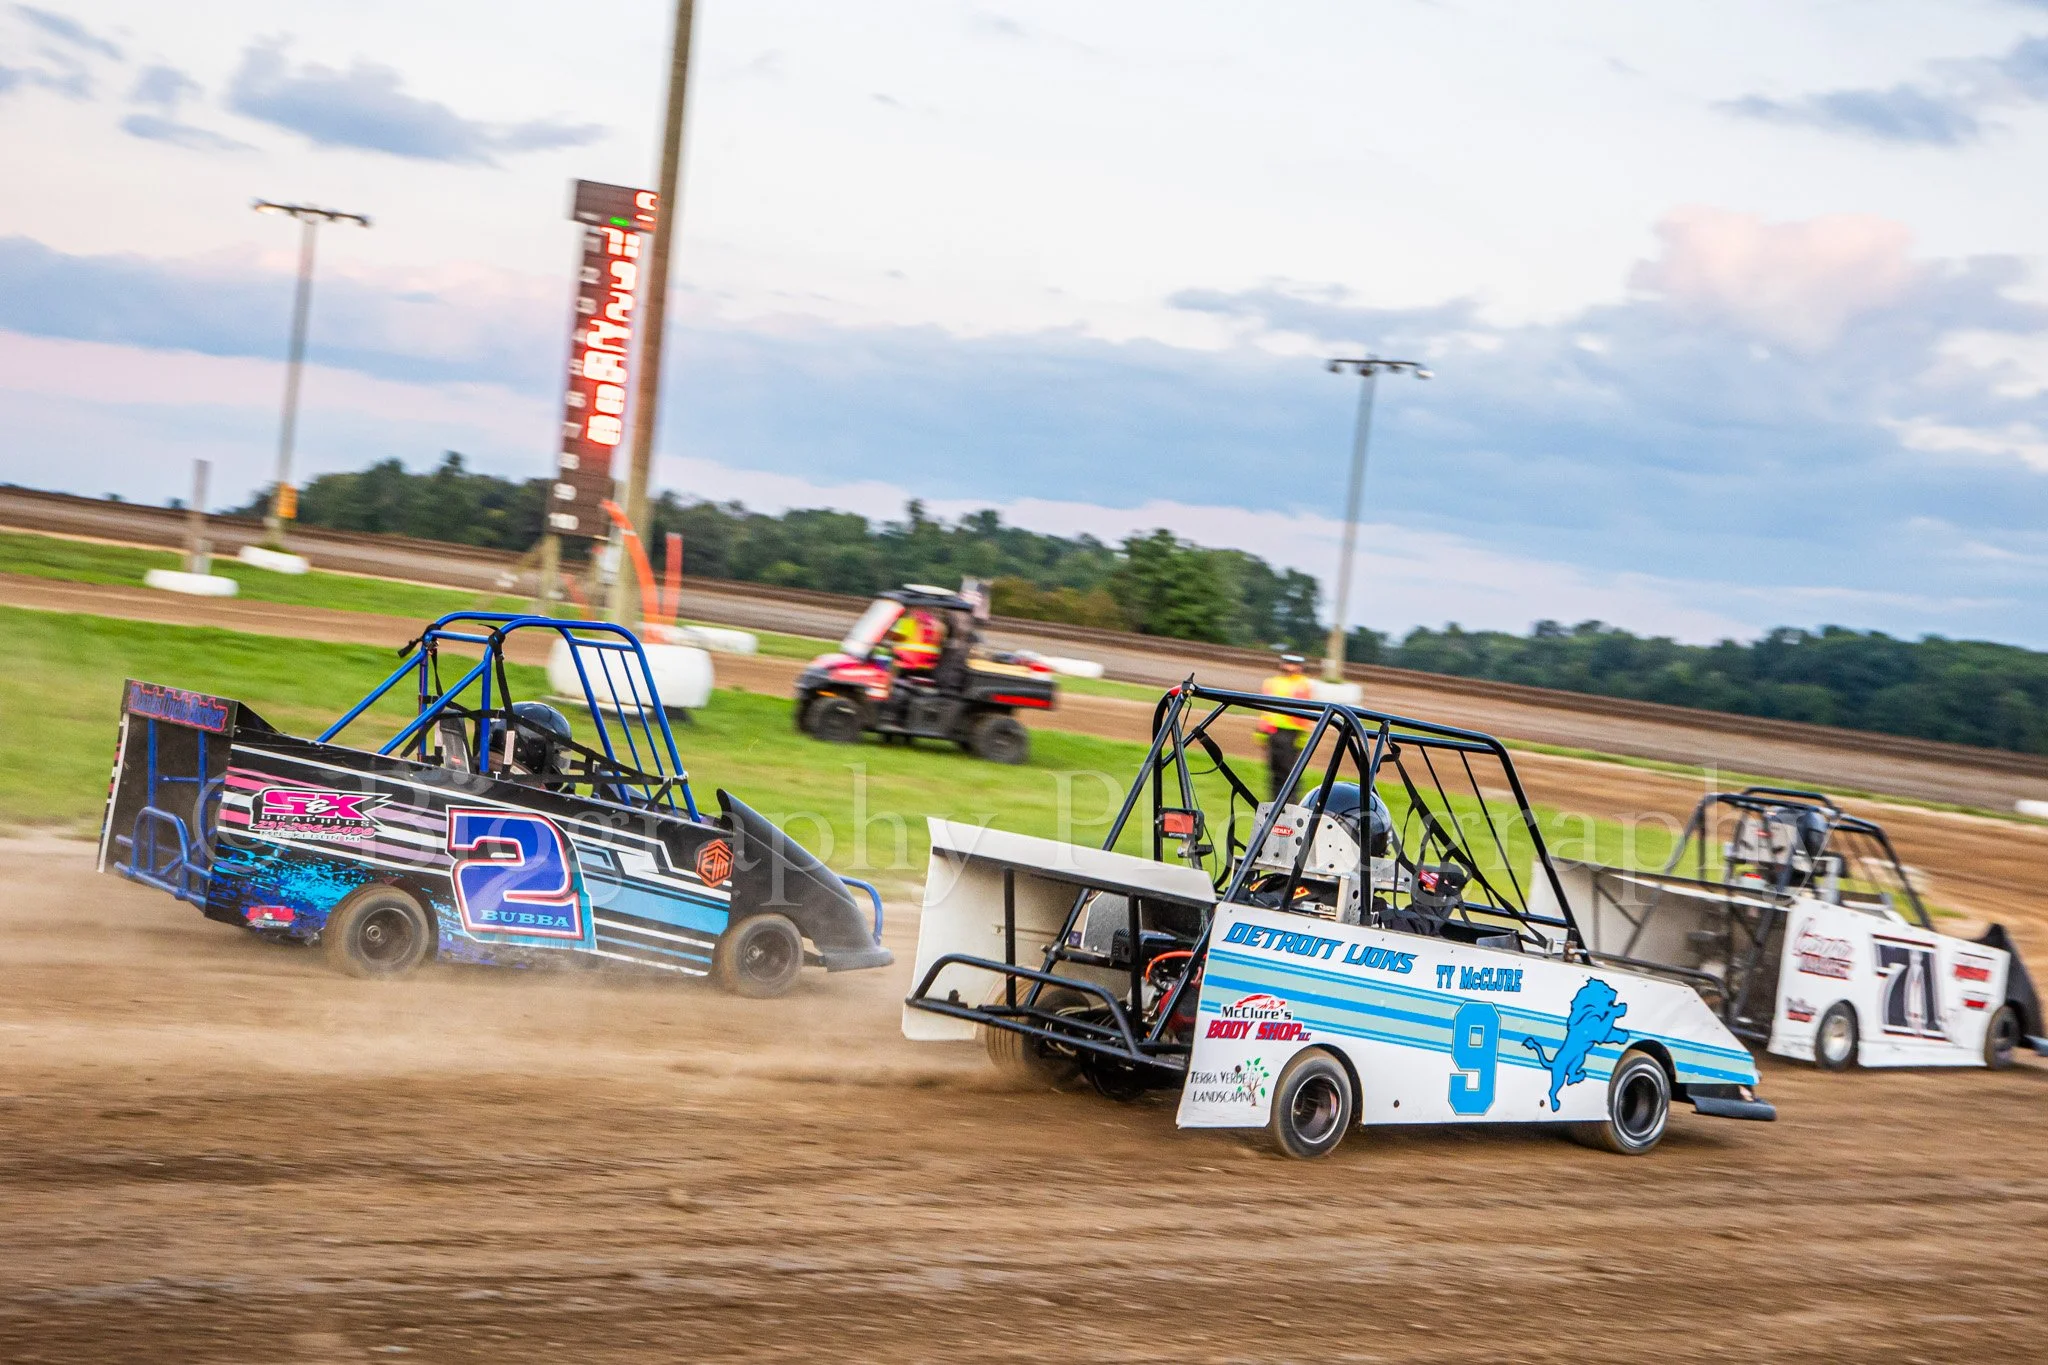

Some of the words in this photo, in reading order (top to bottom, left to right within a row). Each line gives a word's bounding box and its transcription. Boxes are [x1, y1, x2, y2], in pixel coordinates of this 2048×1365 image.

[262, 790, 372, 820] S&K
[260, 814, 370, 827] GRAPHICS
[449, 808, 585, 941] 2
[480, 909, 570, 928] BUBBA
[1222, 922, 1345, 960] DETROIT
[1342, 943, 1419, 974] LIONS
[1436, 965, 1455, 989] TY
[1459, 966, 1523, 992] McCLURE
[1871, 933, 1950, 1042] 71
[1221, 1005, 1292, 1020] McClure's
[1205, 1019, 1254, 1039] BODY
[1255, 1021, 1303, 1041] SHOP
[1448, 1000, 1501, 1116] 9
